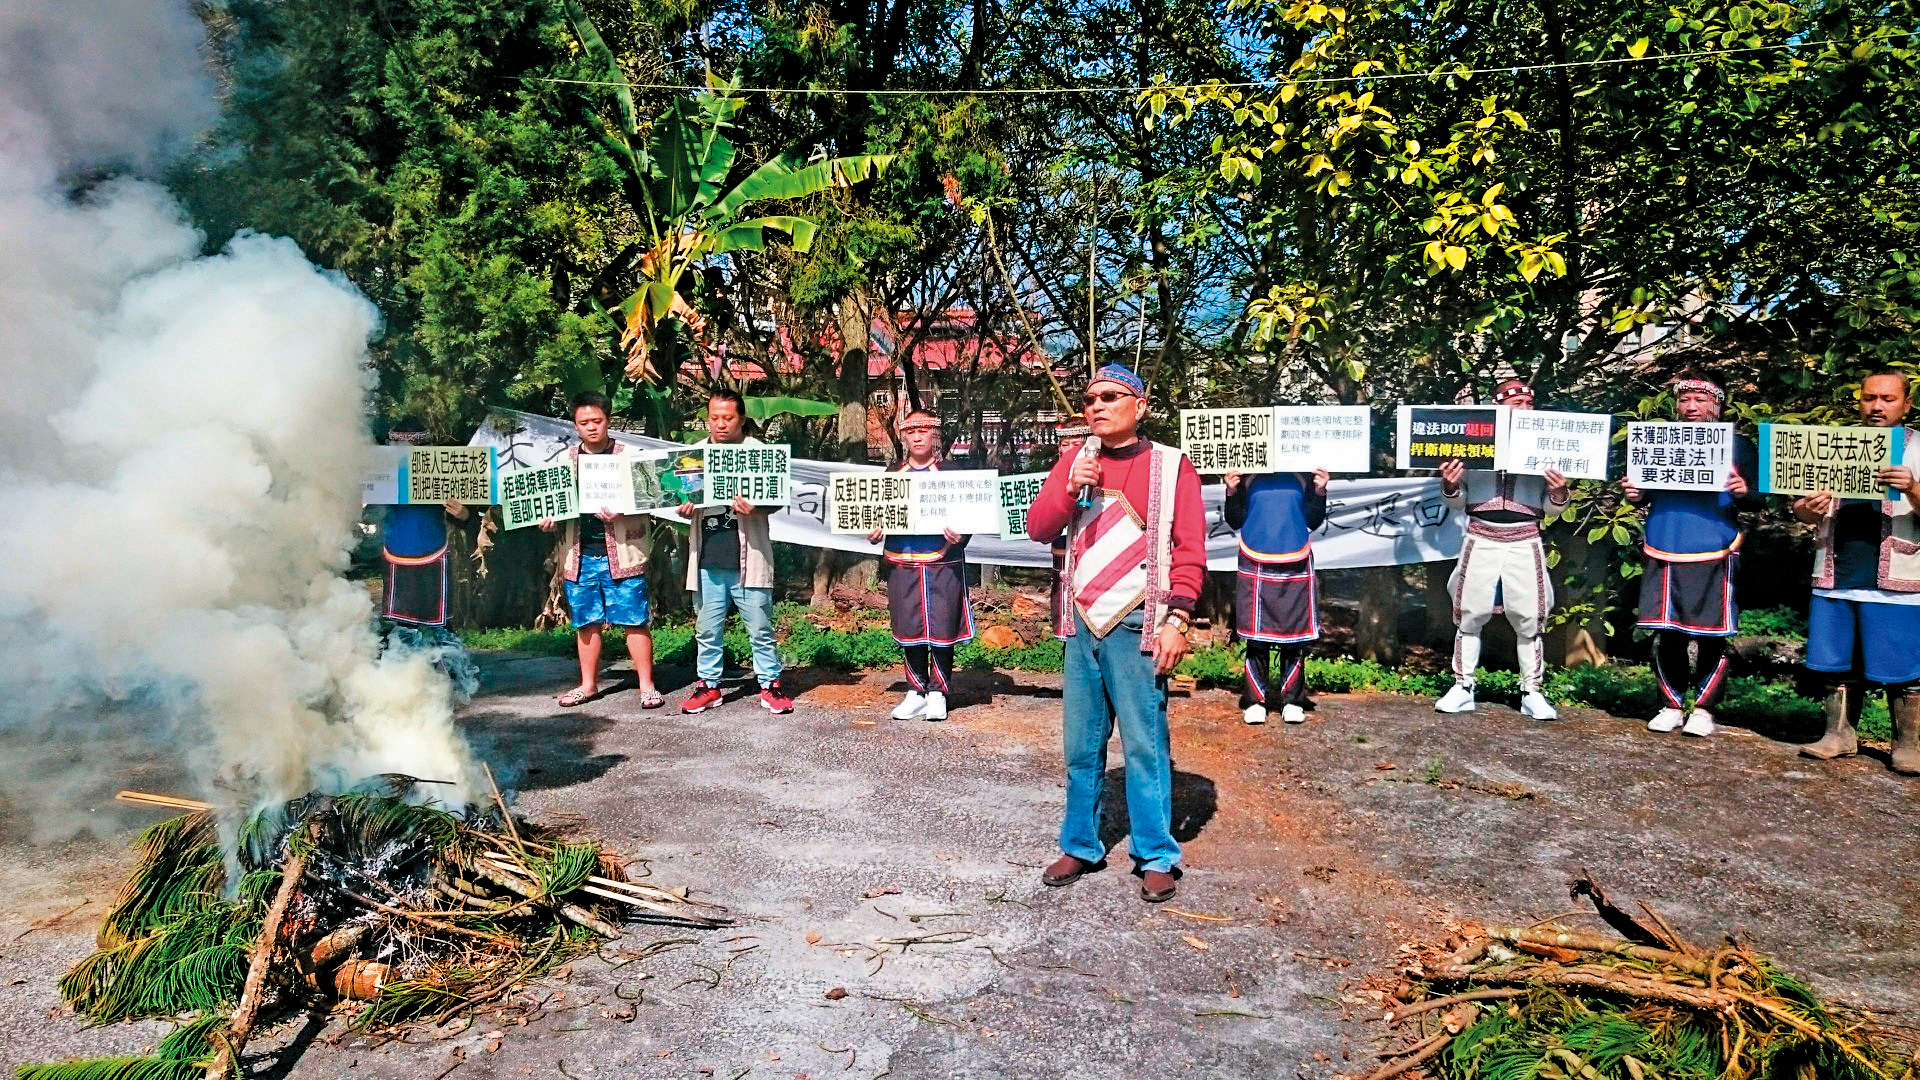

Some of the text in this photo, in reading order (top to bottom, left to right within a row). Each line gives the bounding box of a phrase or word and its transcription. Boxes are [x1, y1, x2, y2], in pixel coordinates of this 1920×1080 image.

[1186, 414, 1270, 440] 反對日月潭BOT
[1280, 416, 1363, 426] 維護傳統領域完整
[1412, 421, 1494, 437] 違法BOT退回
[1516, 417, 1604, 434] 正視平埔族群
[1537, 437, 1580, 453] 原住民
[1632, 426, 1726, 446] 未獲邵族同意BOT
[1776, 430, 1887, 462] 邵族人已失去太多
[1189, 442, 1267, 469] 還我傳統領域
[1281, 443, 1311, 454] 私有地
[1410, 443, 1495, 458] 捍衛傳統領域
[412, 451, 488, 474] 邵族人已失去太多
[708, 448, 788, 474] 拒絕掠奪開發
[1524, 456, 1589, 474] 身分權利
[503, 466, 573, 500] 拒絕掠奪開發
[1642, 468, 1714, 485] 要求退回
[1776, 461, 1887, 494] 別把僅存的都搶走
[412, 477, 488, 500] 別把僅存的都搶走
[834, 477, 911, 502] 反對日月潭BOT
[1000, 477, 1047, 507] 拒絕掠
[838, 505, 909, 530] 還我傳統領域
